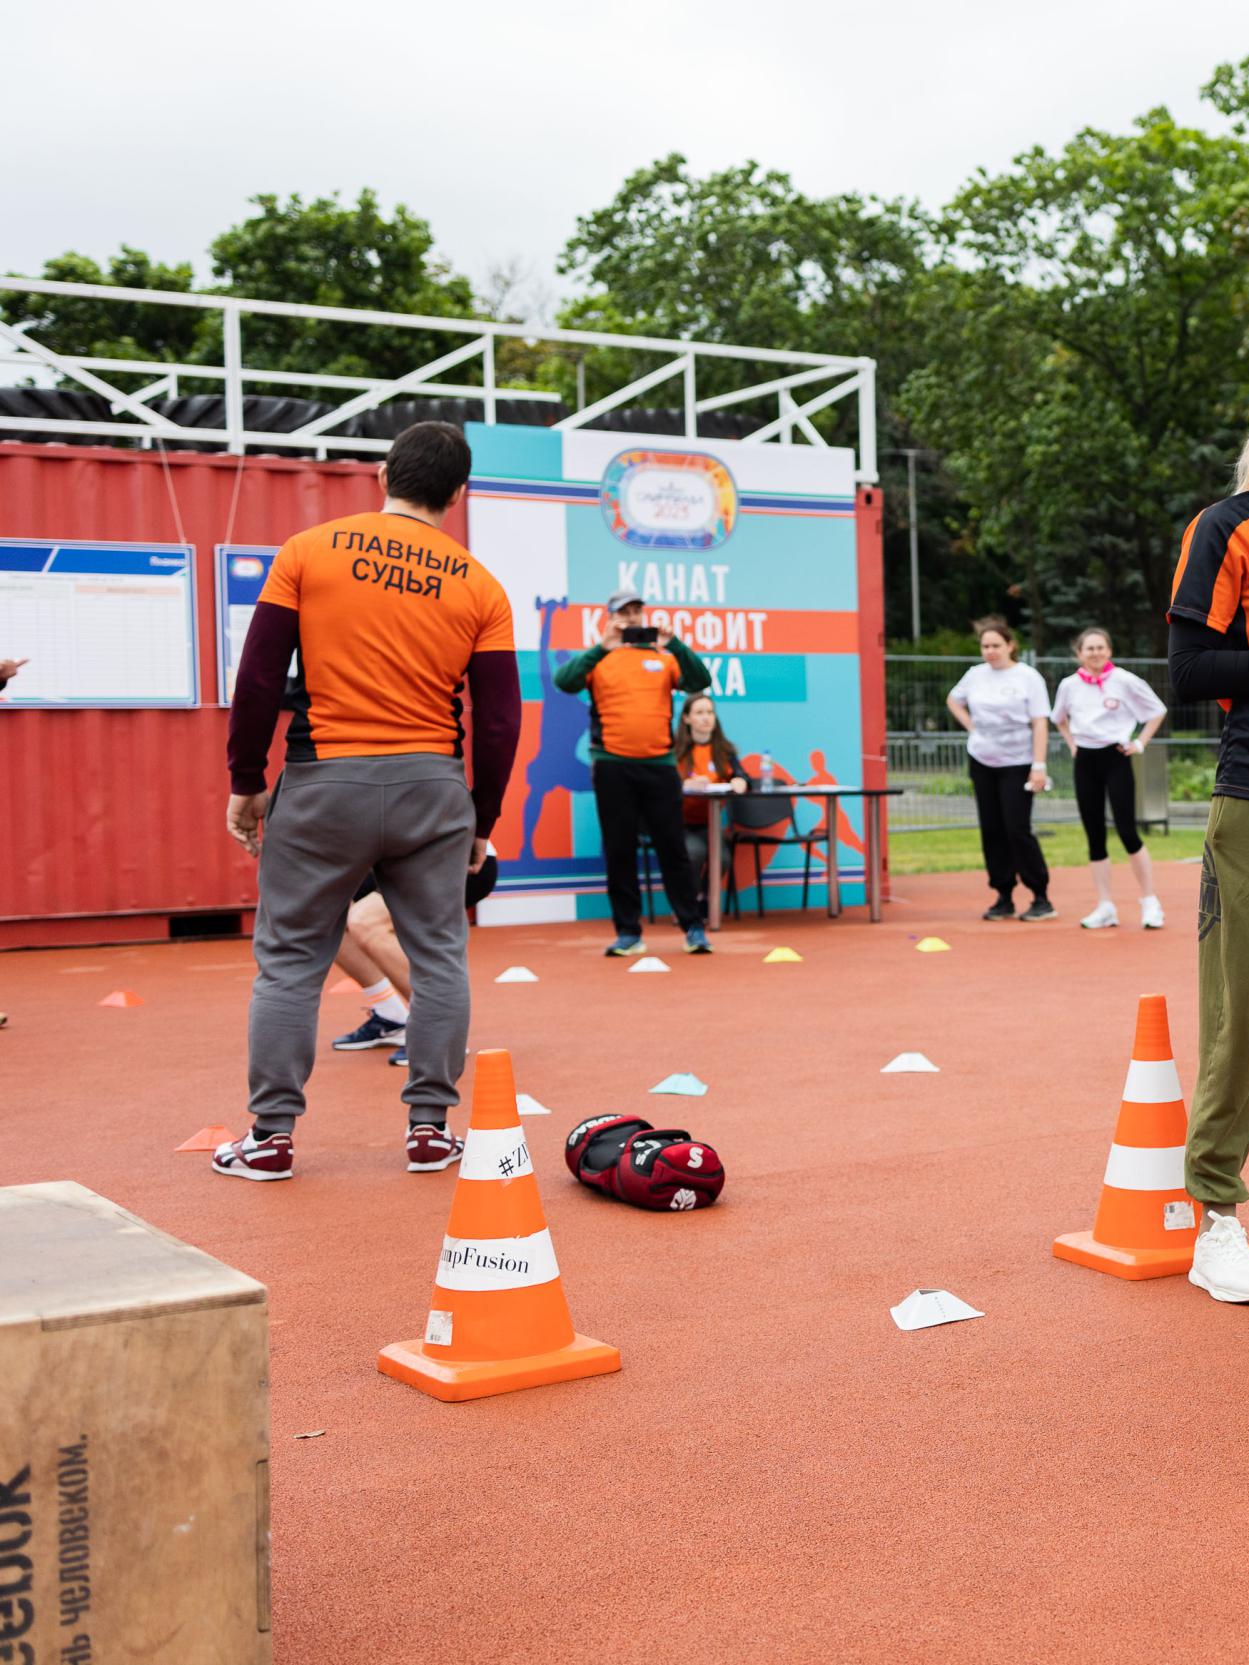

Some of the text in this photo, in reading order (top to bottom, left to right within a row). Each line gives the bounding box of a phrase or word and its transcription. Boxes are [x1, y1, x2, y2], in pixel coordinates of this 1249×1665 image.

[332, 531, 469, 579] ГЛАВНЫЙ
[352, 558, 442, 600] СУДЬЯ
[618, 561, 730, 603] КАНАТ
[581, 607, 767, 650] КСФИТ
